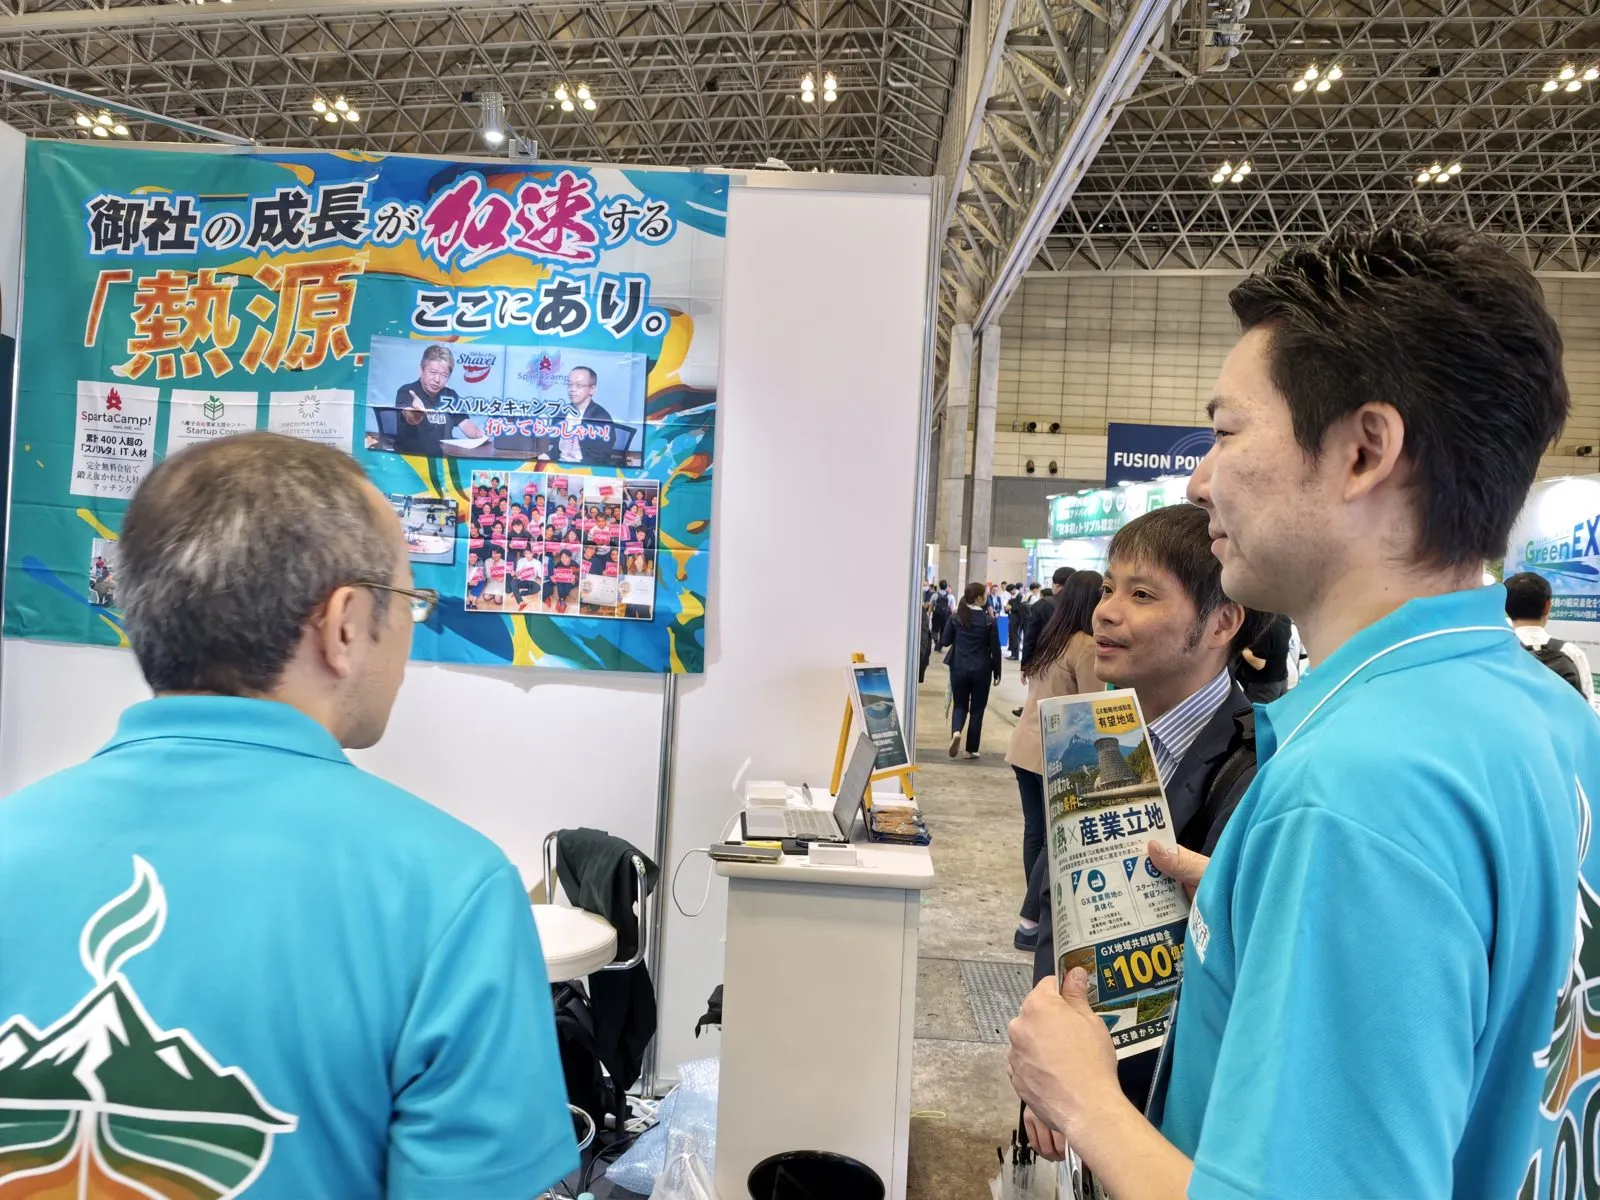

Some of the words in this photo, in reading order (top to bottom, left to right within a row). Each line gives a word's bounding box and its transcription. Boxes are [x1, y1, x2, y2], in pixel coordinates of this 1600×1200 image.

[89, 173, 670, 261] 御社の成長が加速する
[85, 258, 364, 379] 「熱源
[414, 280, 667, 336] ここにあり。
[81, 410, 152, 427] SpartaCamp!
[186, 426, 218, 437] Startup
[101, 435, 117, 444] 400
[118, 436, 144, 447] 人超の
[120, 448, 128, 456] IT
[130, 449, 148, 458] 人材
[1114, 452, 1171, 470] FUSION
[1098, 713, 1136, 728] 有望地域
[1125, 860, 1133, 872] 3
[1073, 874, 1078, 885] 2
[1081, 890, 1123, 906] GX産業用地の
[1094, 901, 1115, 913] 具体化
[1101, 930, 1172, 957] GX地域共創補助金
[1103, 968, 1116, 988] 最大
